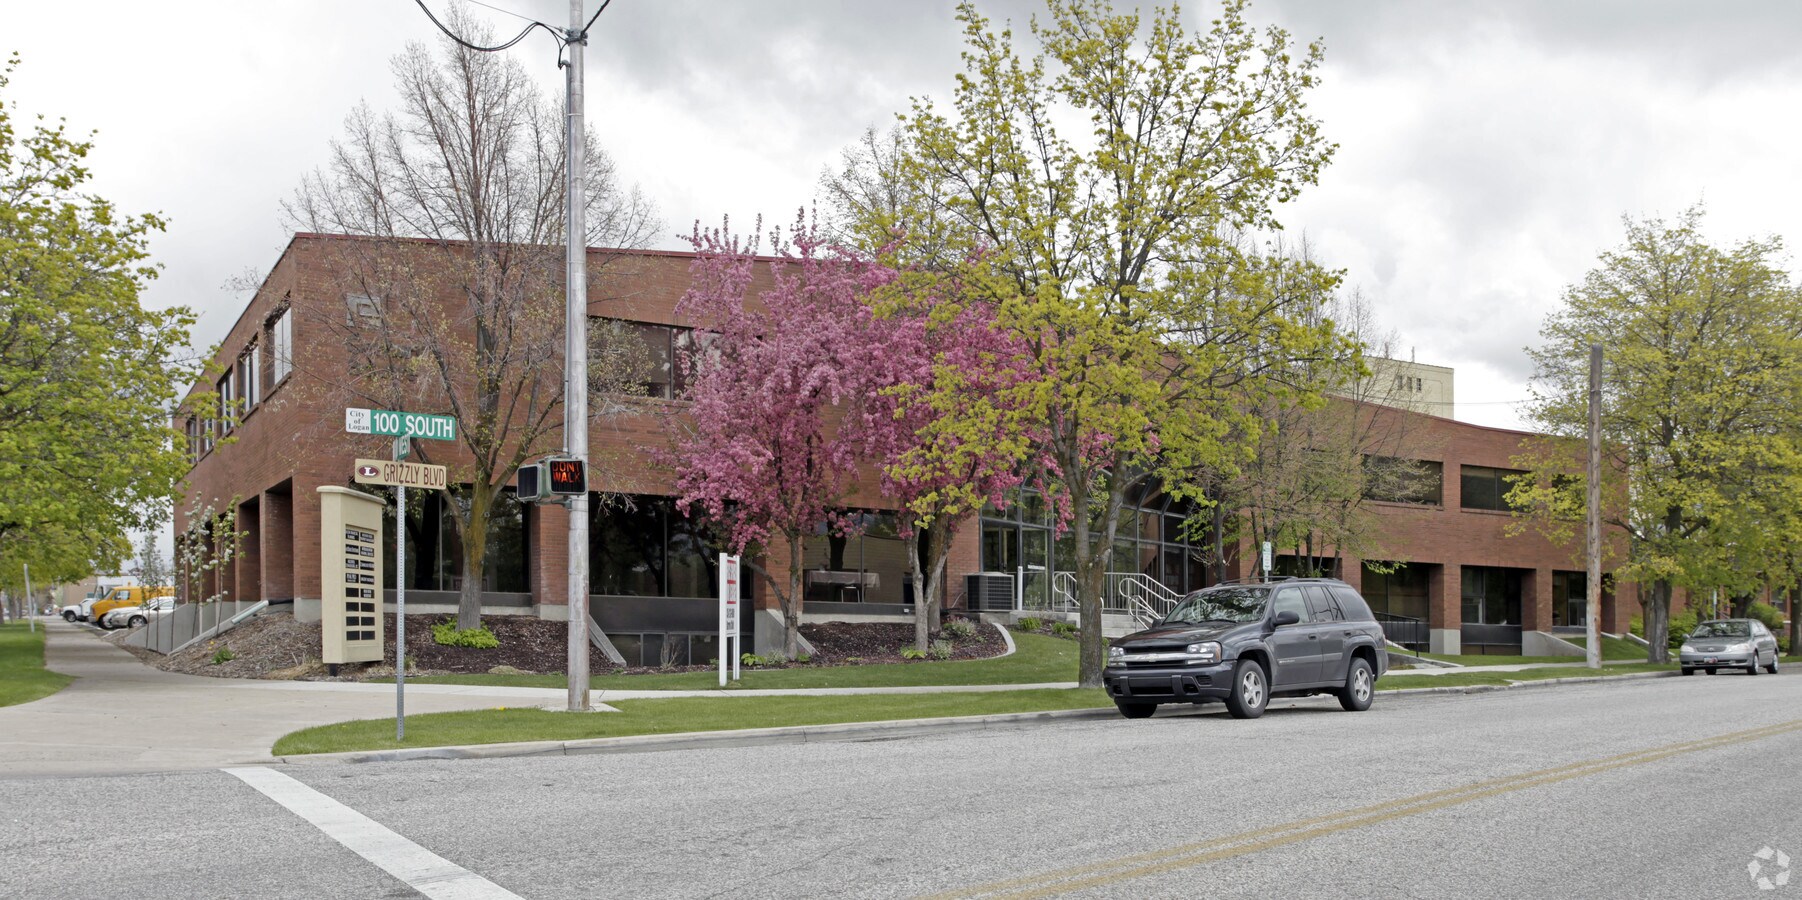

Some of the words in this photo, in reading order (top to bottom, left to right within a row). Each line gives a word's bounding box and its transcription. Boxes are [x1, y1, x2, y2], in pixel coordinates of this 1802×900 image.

[350, 410, 365, 418] City
[373, 413, 399, 433] 100
[405, 415, 453, 438] SOUTH
[364, 467, 376, 477] L
[384, 464, 420, 484] GRIZZLY
[553, 472, 580, 483] WALK
